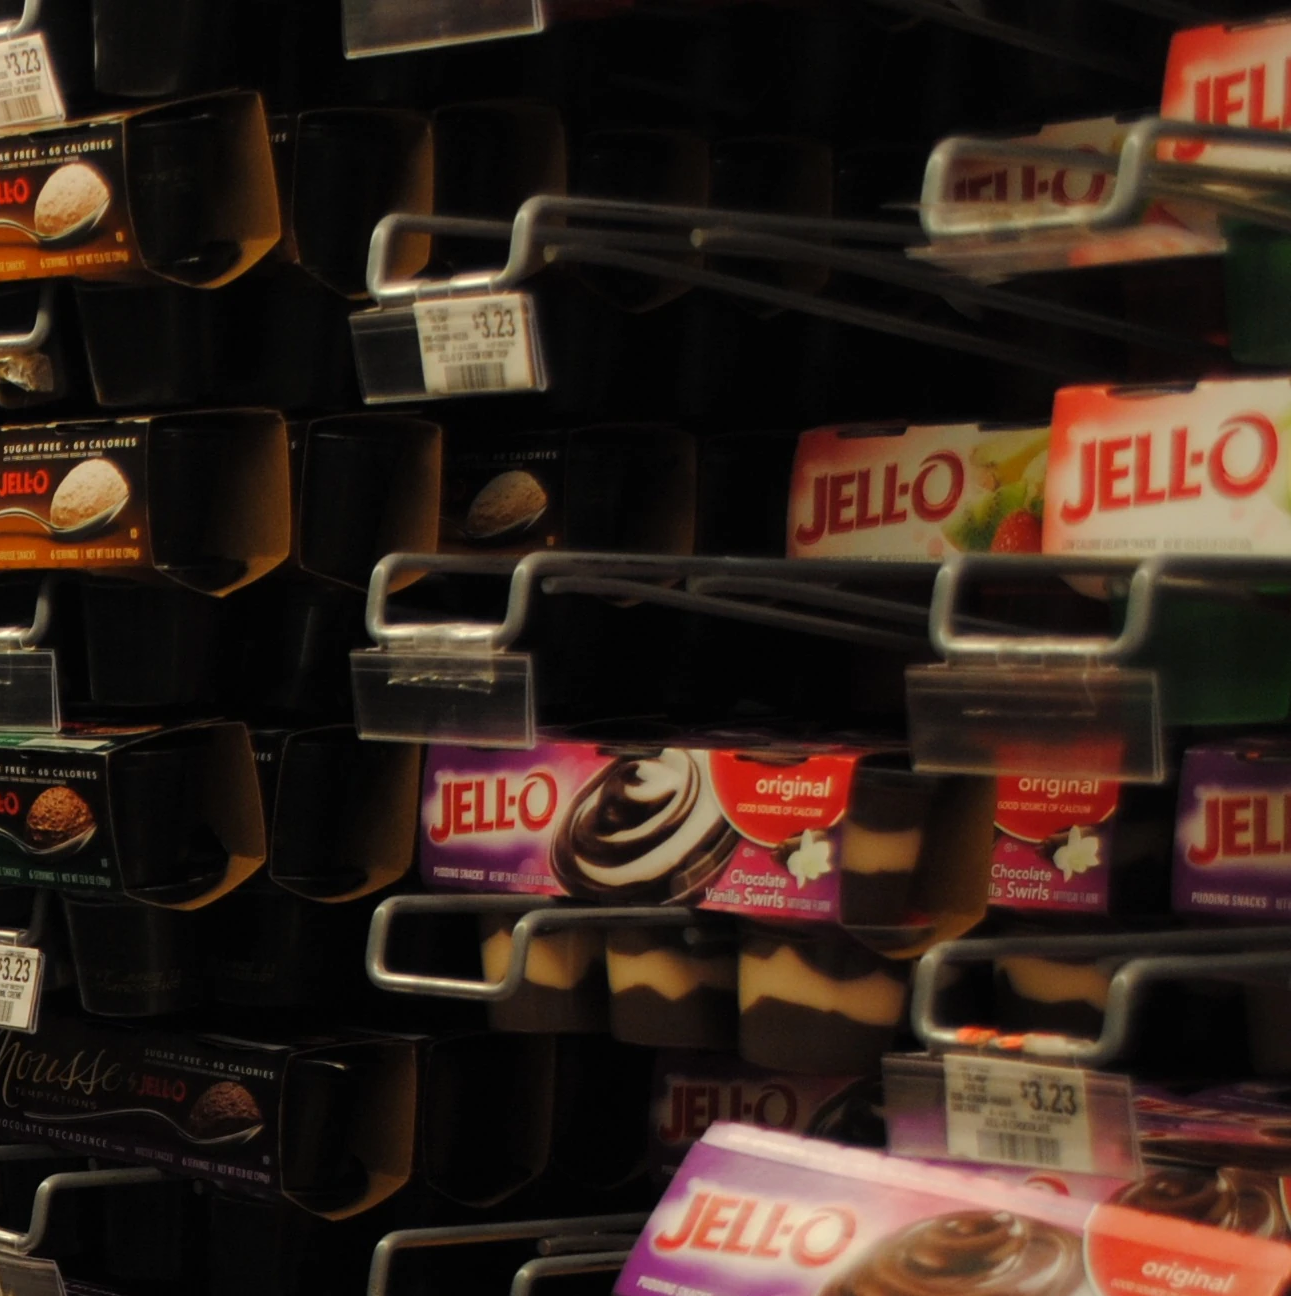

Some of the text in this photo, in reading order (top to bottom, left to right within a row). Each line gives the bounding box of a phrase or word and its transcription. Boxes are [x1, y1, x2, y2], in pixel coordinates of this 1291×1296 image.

[472, 307, 518, 342] $3.23
[1060, 409, 1281, 527] JELL-O
[755, 776, 830, 801] original
[428, 772, 558, 844] JELL-O
[730, 869, 786, 889] Chocolate
[991, 864, 1052, 883] Chocolate
[705, 887, 784, 910] Vanilla Swirls
[1018, 1078, 1079, 1118] $3.23
[652, 1191, 858, 1269] JELL-O
[1140, 1257, 1235, 1295] original
